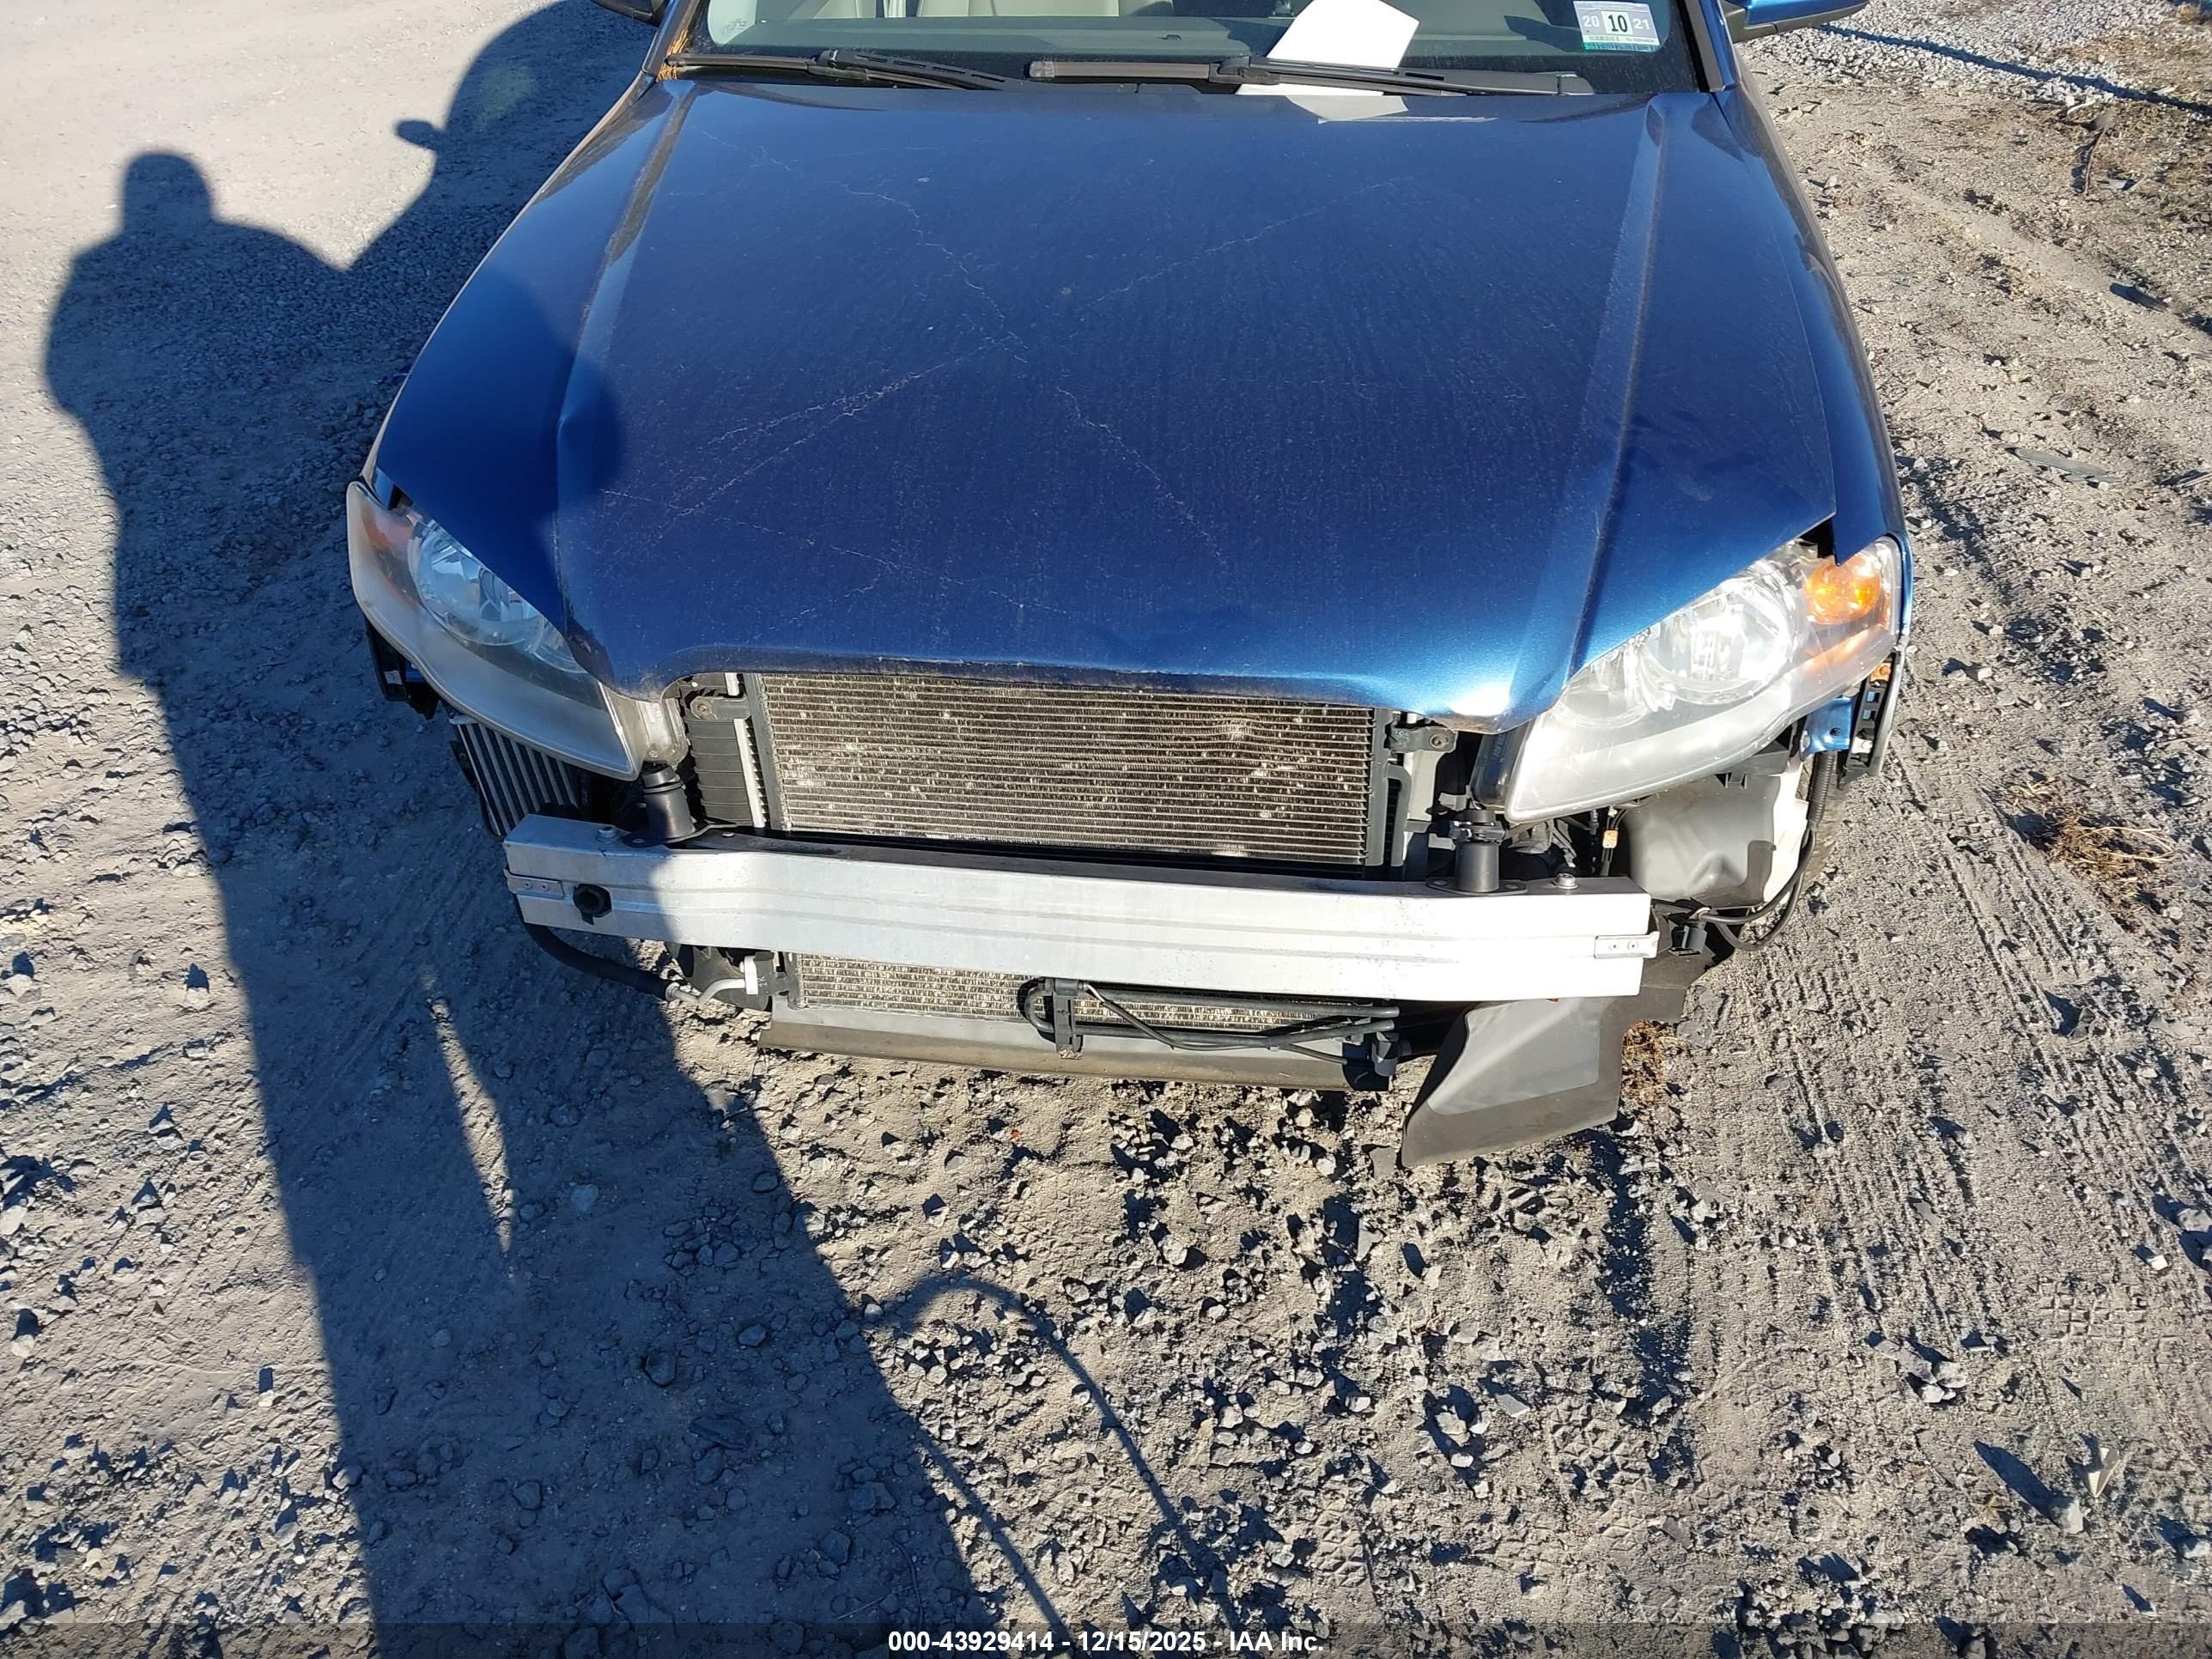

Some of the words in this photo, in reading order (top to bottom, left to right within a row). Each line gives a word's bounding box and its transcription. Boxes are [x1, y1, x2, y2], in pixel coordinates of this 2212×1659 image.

[1582, 15, 1600, 27] 20
[1607, 14, 1628, 33] 10
[1632, 17, 1650, 29] 21
